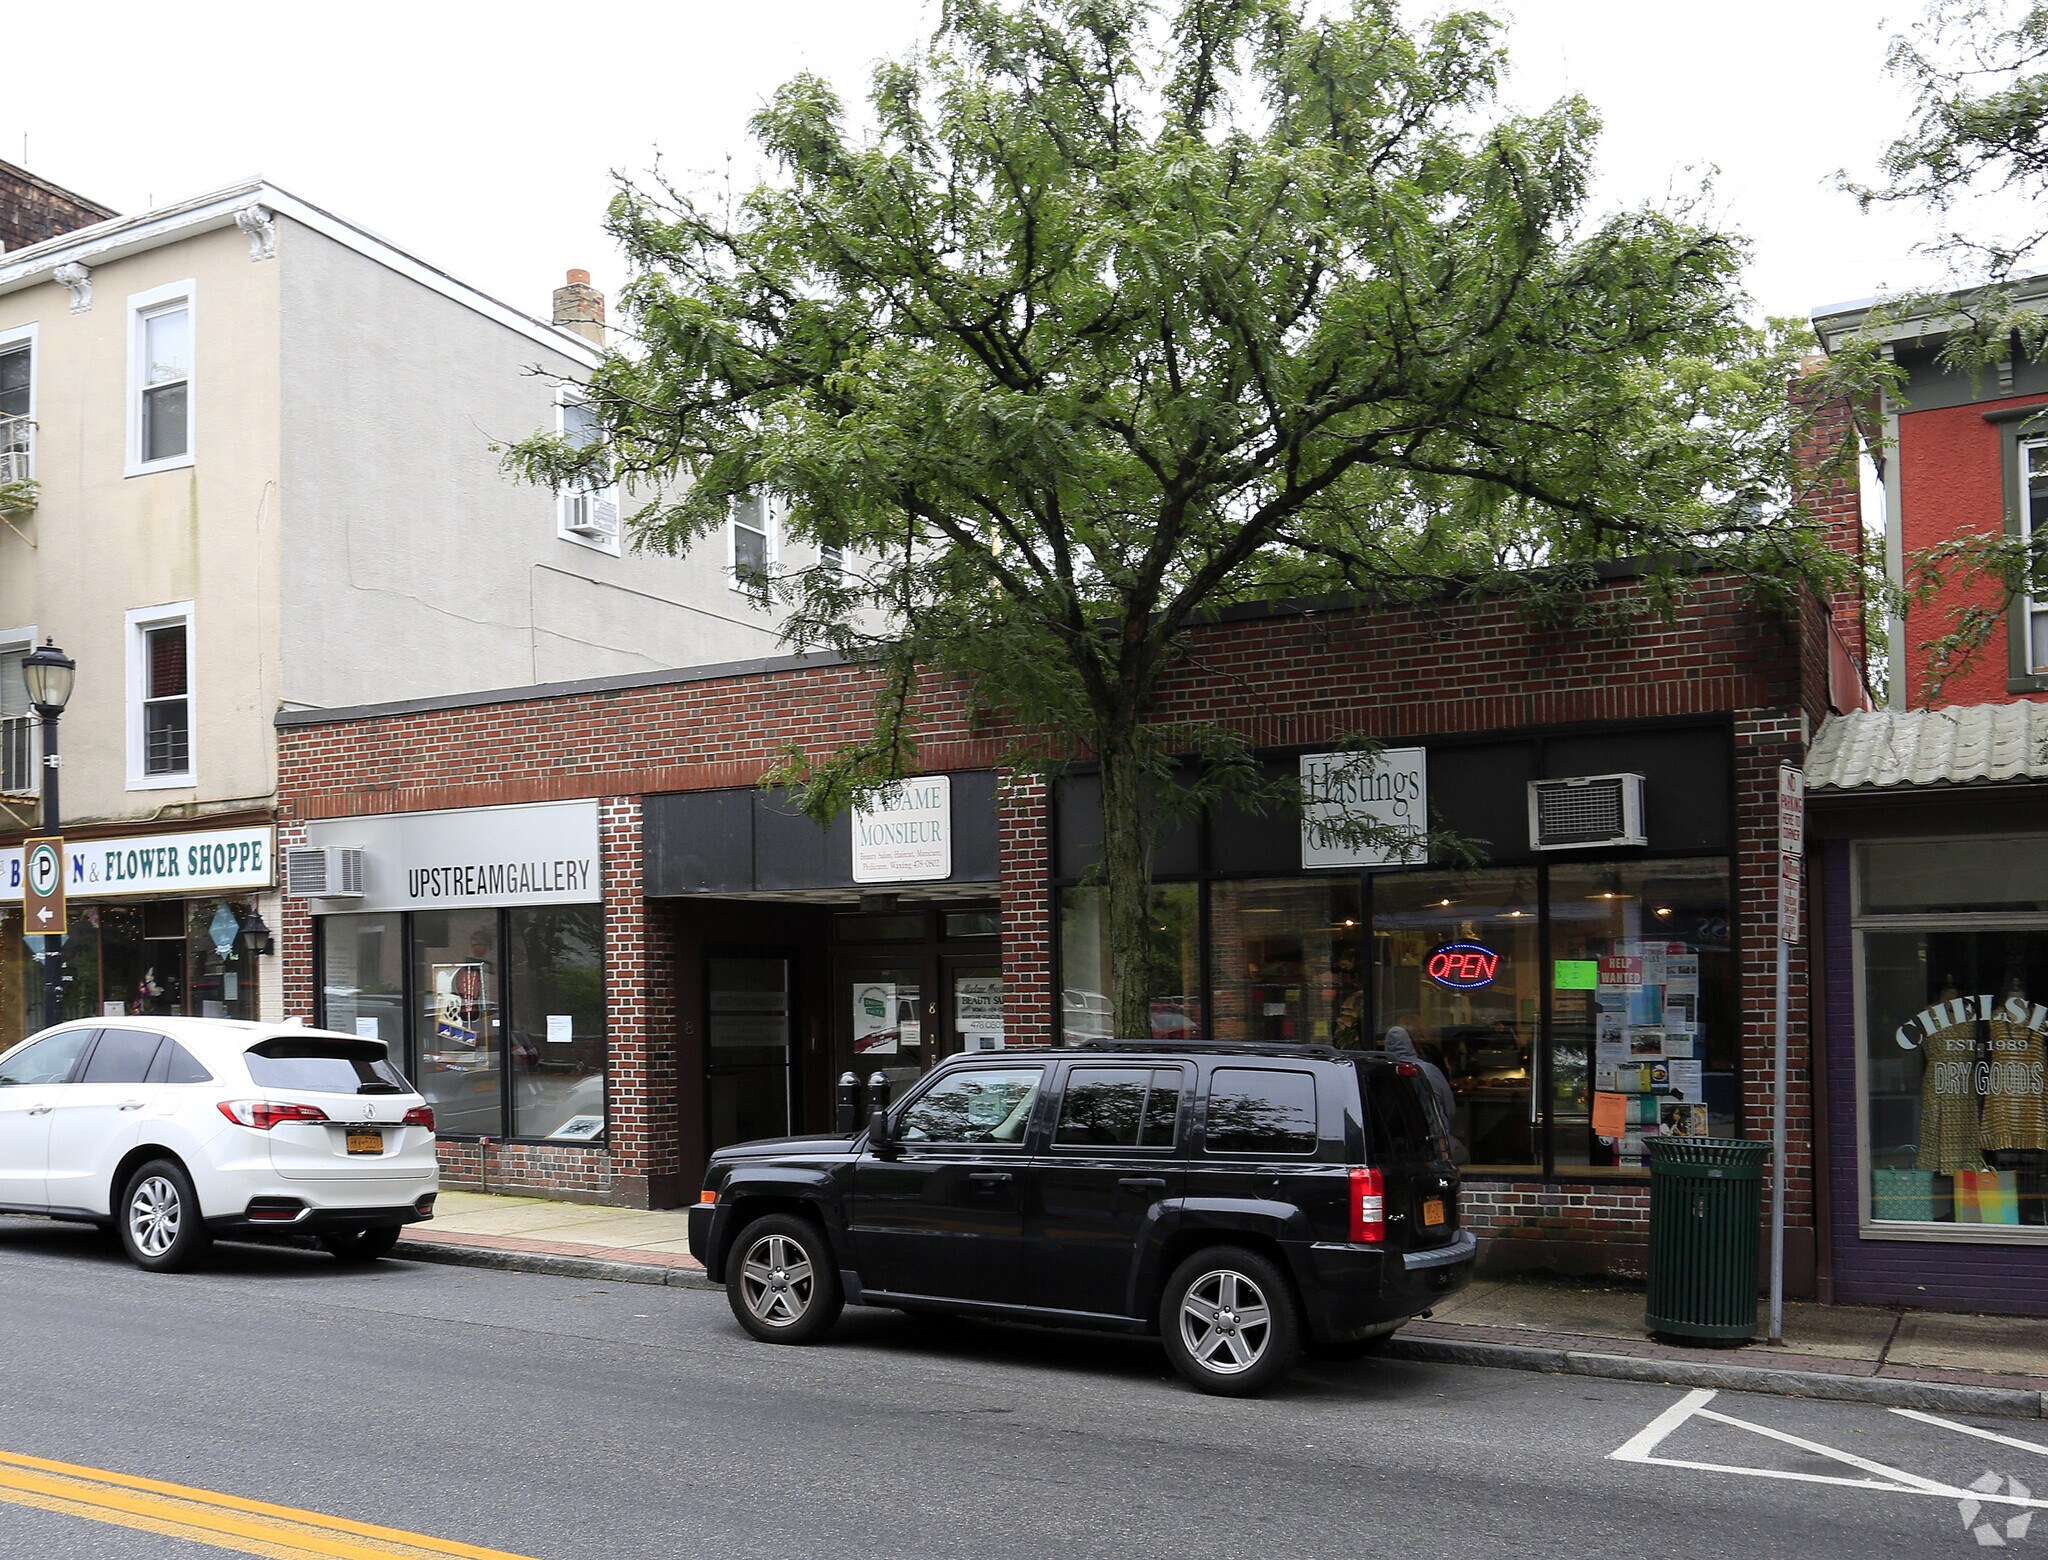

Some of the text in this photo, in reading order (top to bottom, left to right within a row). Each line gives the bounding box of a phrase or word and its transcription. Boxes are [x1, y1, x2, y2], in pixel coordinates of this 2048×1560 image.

[1308, 762, 1419, 816] Hastings
[1787, 775, 1797, 792] NO
[861, 786, 942, 813] ADAME
[1781, 794, 1802, 813] PARKING
[1782, 812, 1801, 828] HERE TO
[860, 820, 942, 847] MONSIEUR
[1782, 826, 1800, 841] CORNER
[39, 855, 51, 885] P
[89, 862, 100, 883] &
[105, 846, 180, 882] FLOWER
[188, 840, 263, 876] SHOPPE
[1428, 953, 1498, 978] OPEN
[1608, 957, 1632, 969] HELP
[1600, 972, 1641, 984] WANTED
[962, 996, 991, 1005] BEAUTY
[1946, 1039, 2029, 1051] EST. 1989
[1935, 1061, 2044, 1095] DRY GOODS
